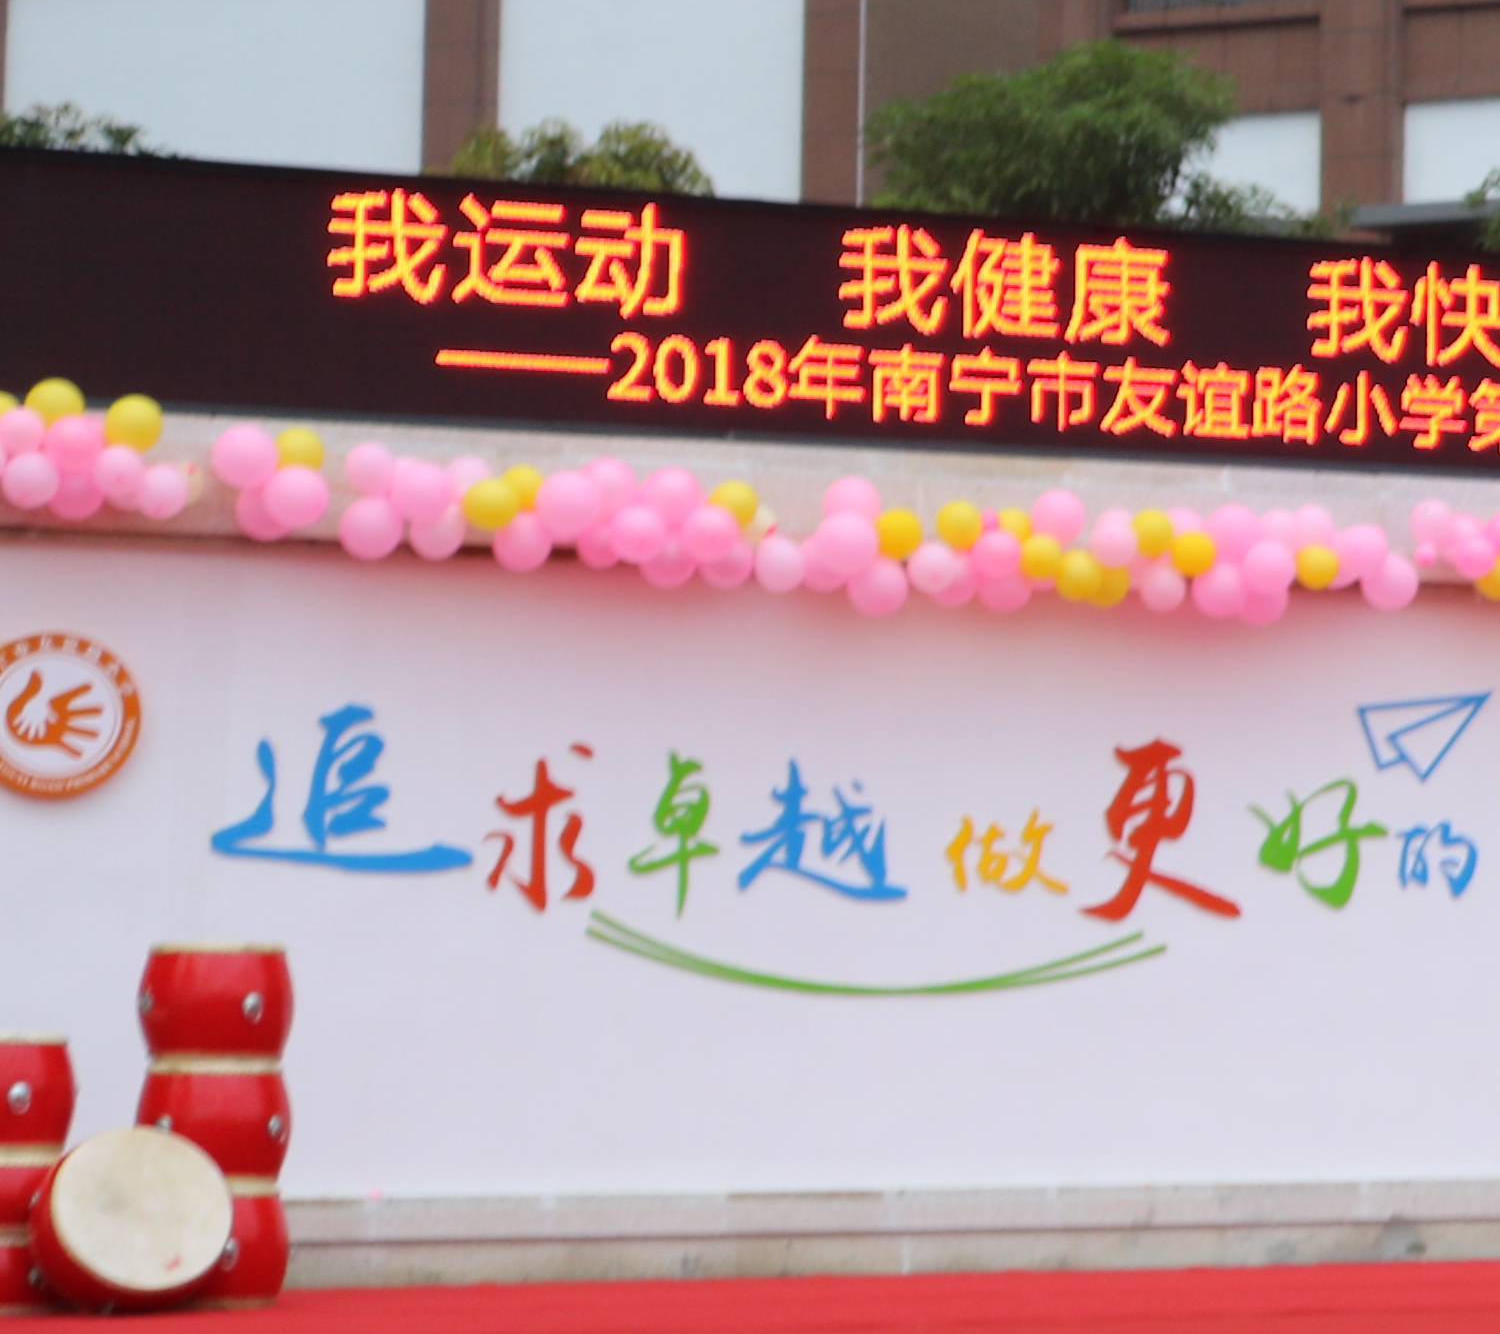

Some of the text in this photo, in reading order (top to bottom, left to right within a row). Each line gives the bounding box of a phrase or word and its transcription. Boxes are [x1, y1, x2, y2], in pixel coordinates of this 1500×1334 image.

[326, 186, 687, 320] 我运动
[838, 223, 1173, 348] 我健康
